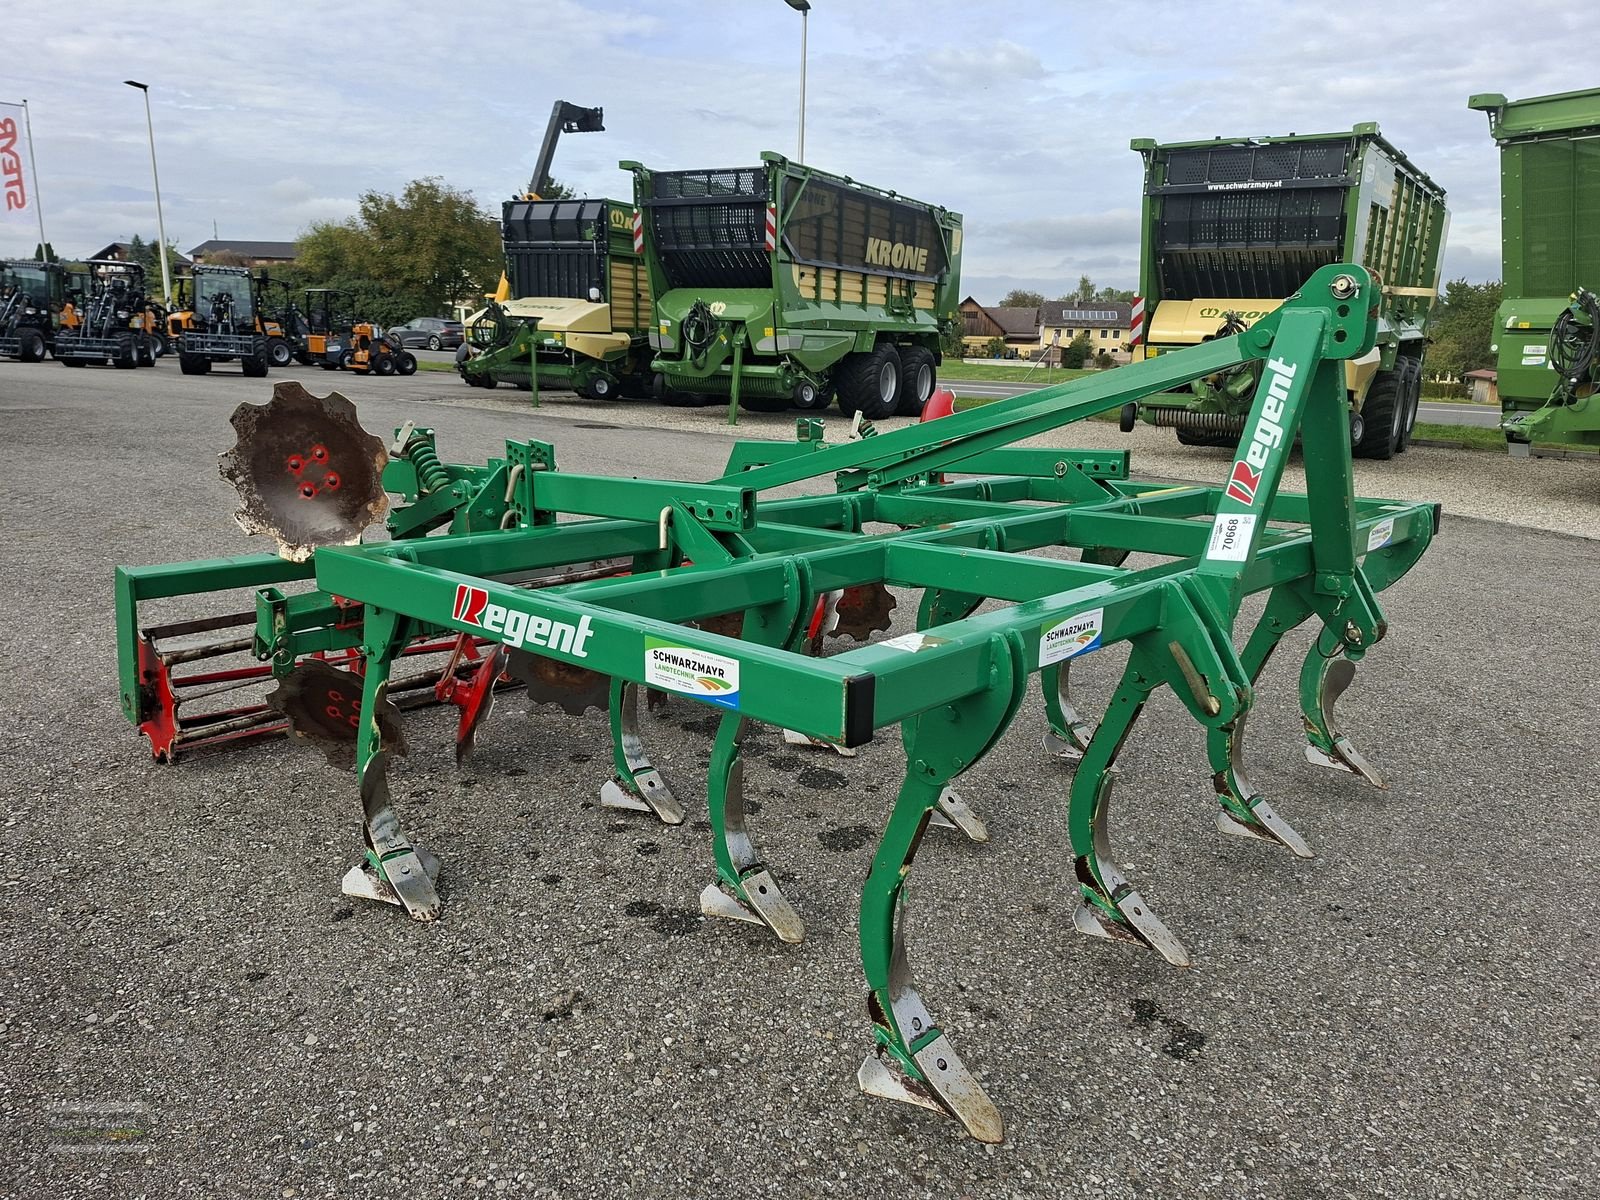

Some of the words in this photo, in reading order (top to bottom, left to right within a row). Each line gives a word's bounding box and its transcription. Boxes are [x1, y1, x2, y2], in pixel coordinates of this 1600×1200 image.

[1207, 180, 1283, 191] www.schwarzmayr.at
[865, 237, 929, 273] KRONE
[1225, 356, 1297, 507] Regent
[1222, 519, 1239, 550] 70668
[452, 583, 594, 658] Regent
[1046, 620, 1095, 642] SCHWARZMAYR
[653, 650, 725, 678] SCHWARZMAYR
[654, 662, 696, 680] LANDTECHNIK
